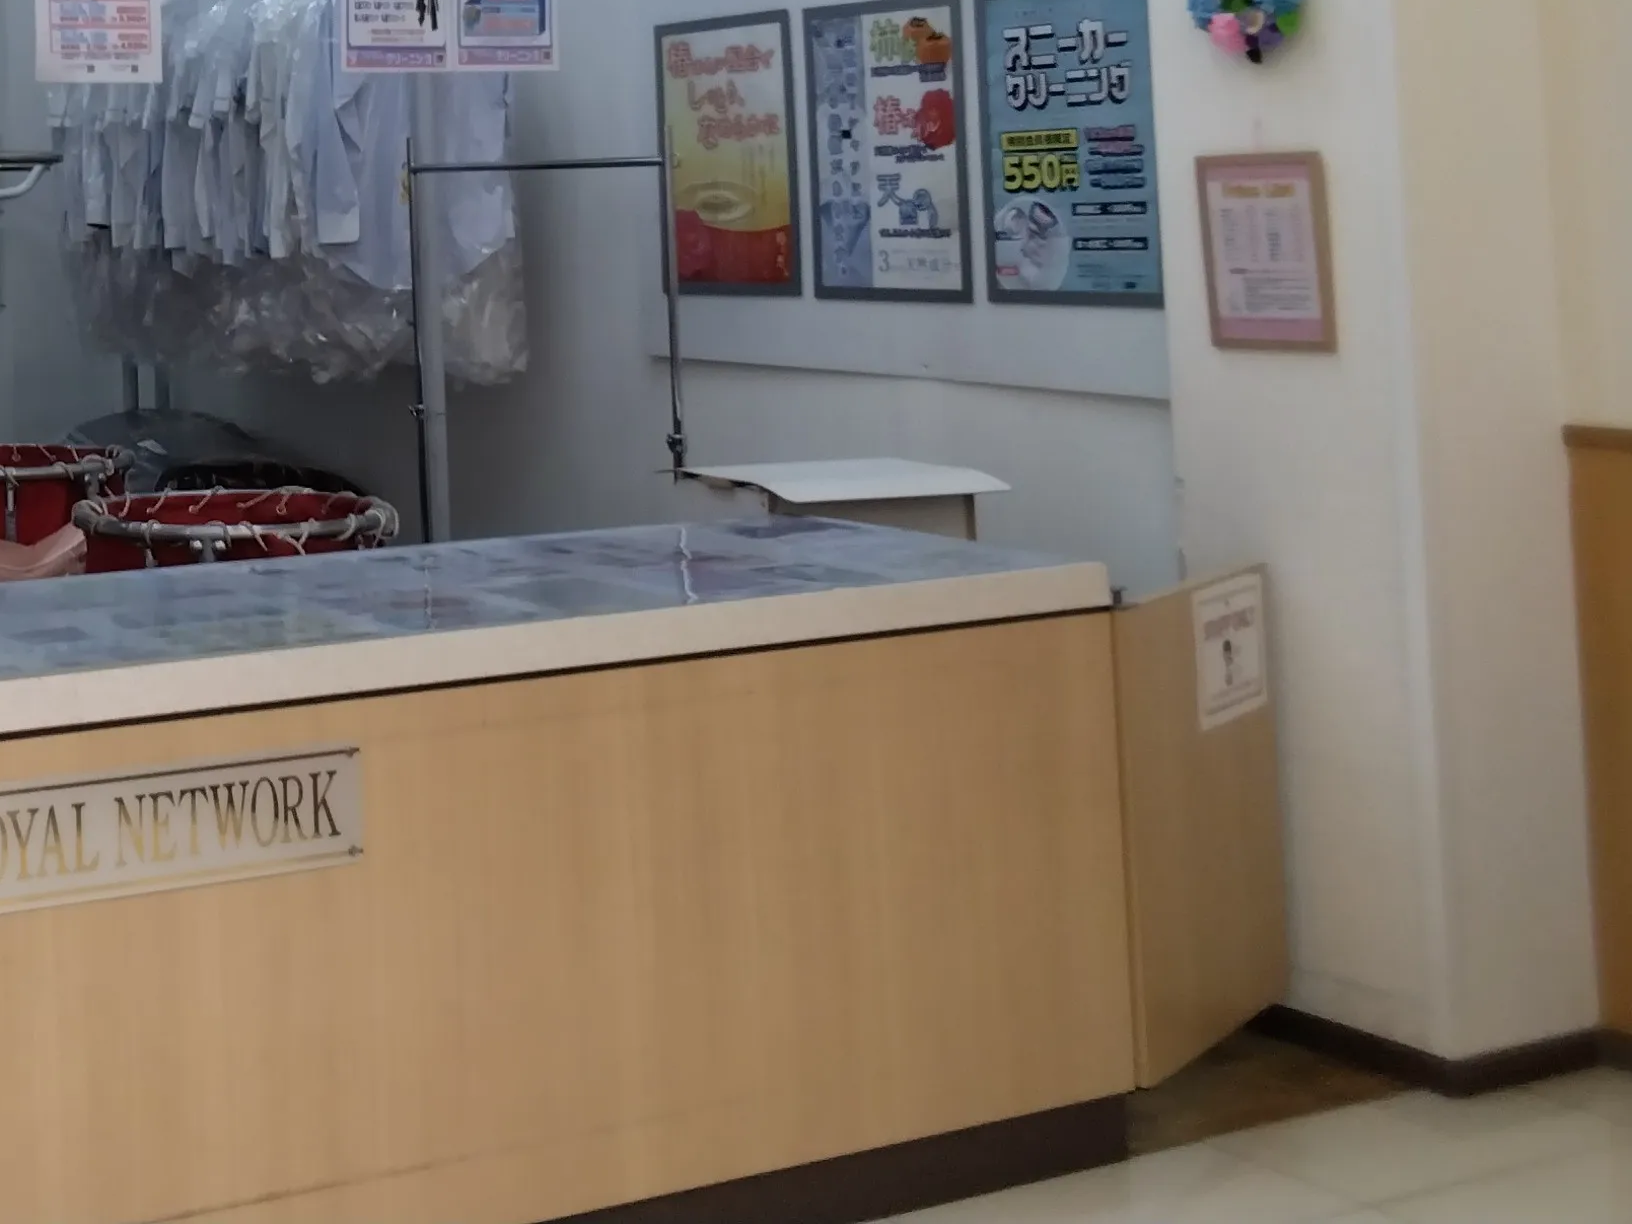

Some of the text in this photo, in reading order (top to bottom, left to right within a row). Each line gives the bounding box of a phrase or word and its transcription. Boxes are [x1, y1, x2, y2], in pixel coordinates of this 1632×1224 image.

[1002, 18, 1129, 71] スニーカー
[1005, 60, 1133, 110] クリーニング
[114, 769, 342, 868] NETWORK
